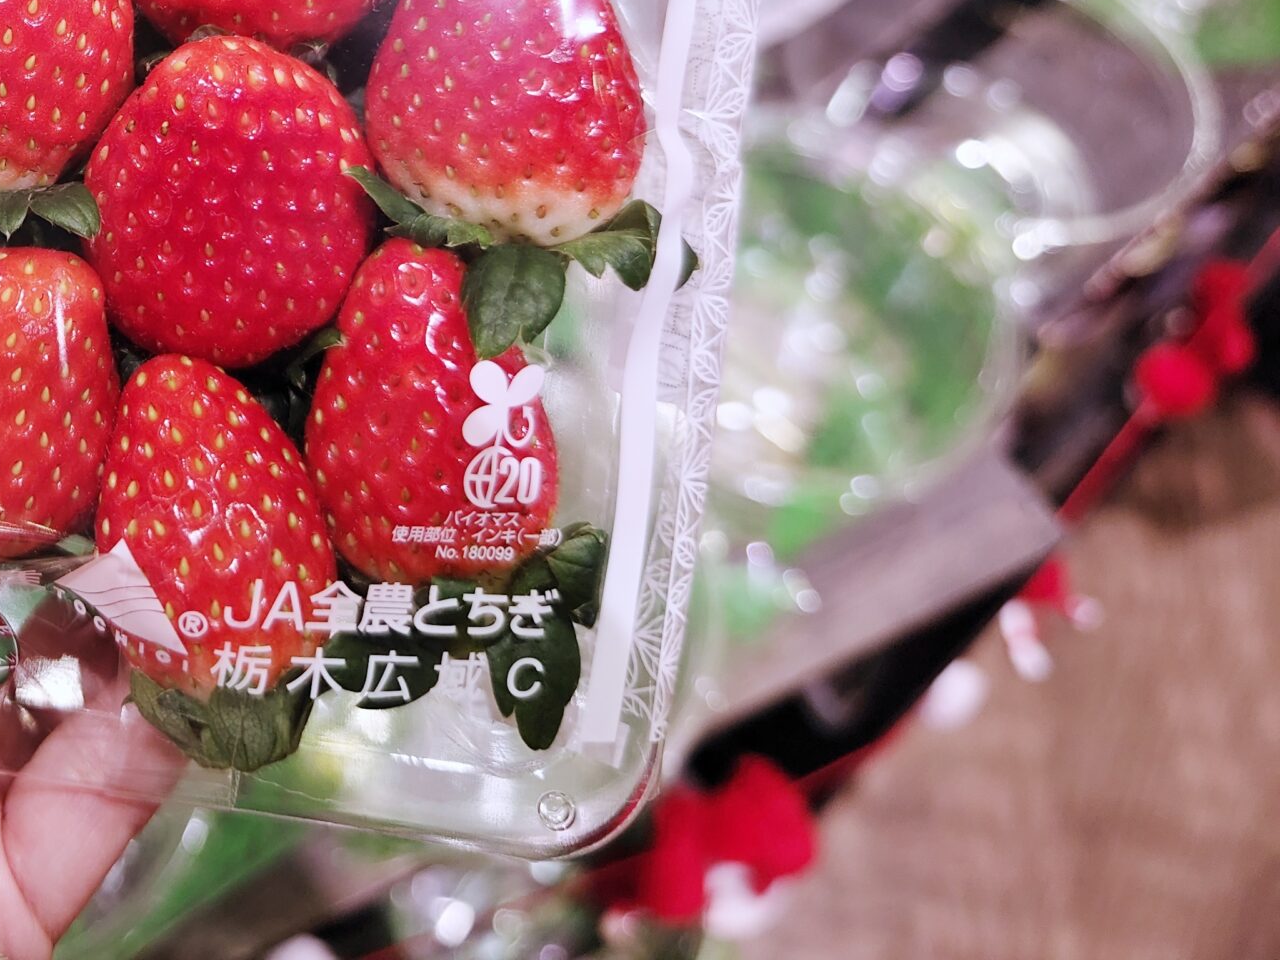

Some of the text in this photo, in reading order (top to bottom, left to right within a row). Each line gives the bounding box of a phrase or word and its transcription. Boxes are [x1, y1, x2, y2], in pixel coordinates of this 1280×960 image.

[494, 456, 542, 505] 20
[443, 510, 520, 527] バイオマス
[434, 544, 515, 561] No.180099
[223, 578, 562, 638] JA全農とちぎ
